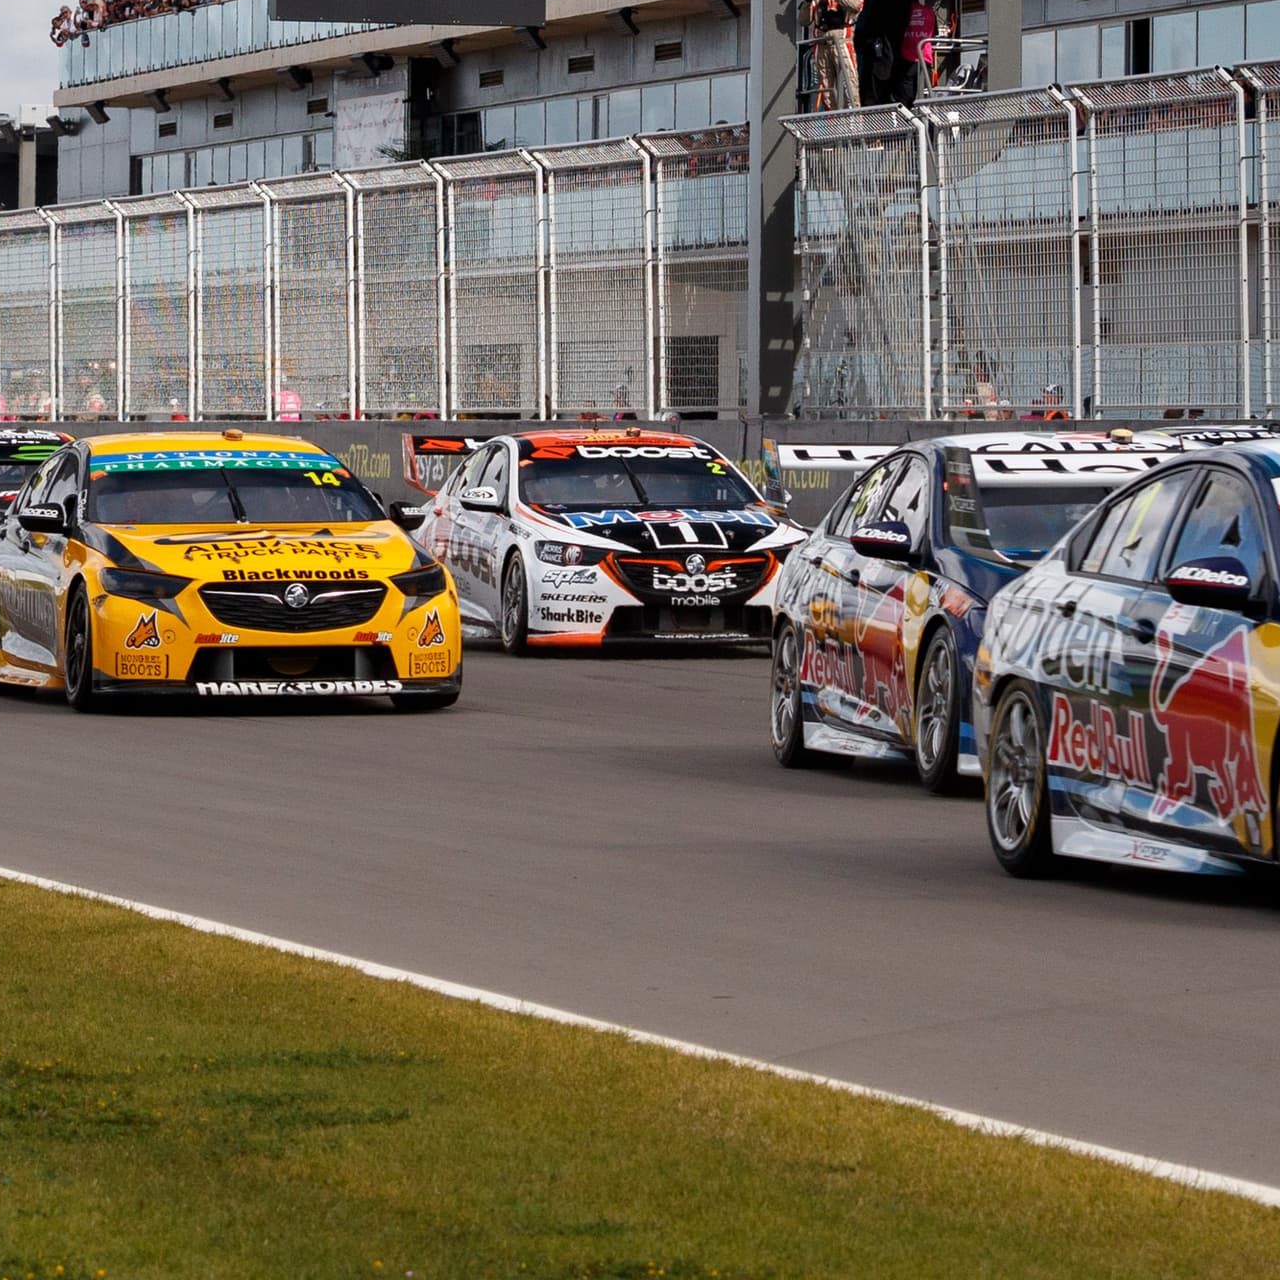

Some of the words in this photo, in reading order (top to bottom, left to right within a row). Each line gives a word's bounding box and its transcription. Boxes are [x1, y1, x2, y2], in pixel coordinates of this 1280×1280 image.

[127, 451, 304, 460] NATIONAL
[576, 445, 712, 460] boost
[105, 459, 332, 470] PHARMACIES
[706, 462, 727, 475] 2
[304, 471, 341, 487] 14
[561, 508, 779, 528] Mobil
[669, 521, 699, 542] 1
[184, 538, 377, 554] ALLIANCE
[201, 548, 282, 560] TRUCK
[291, 549, 368, 560] PARTS
[223, 568, 370, 581] Blackwoods
[652, 567, 738, 591] boost
[1173, 566, 1249, 588] ACDelco
[540, 592, 608, 603] SKECHERS
[671, 595, 721, 607] mobile
[194, 631, 240, 644] Autolite
[353, 631, 394, 644] Autolite
[121, 664, 162, 677] BOOTS
[413, 661, 447, 674] BOOTS
[1047, 692, 1102, 773] Red
[1101, 704, 1154, 790] Bull
